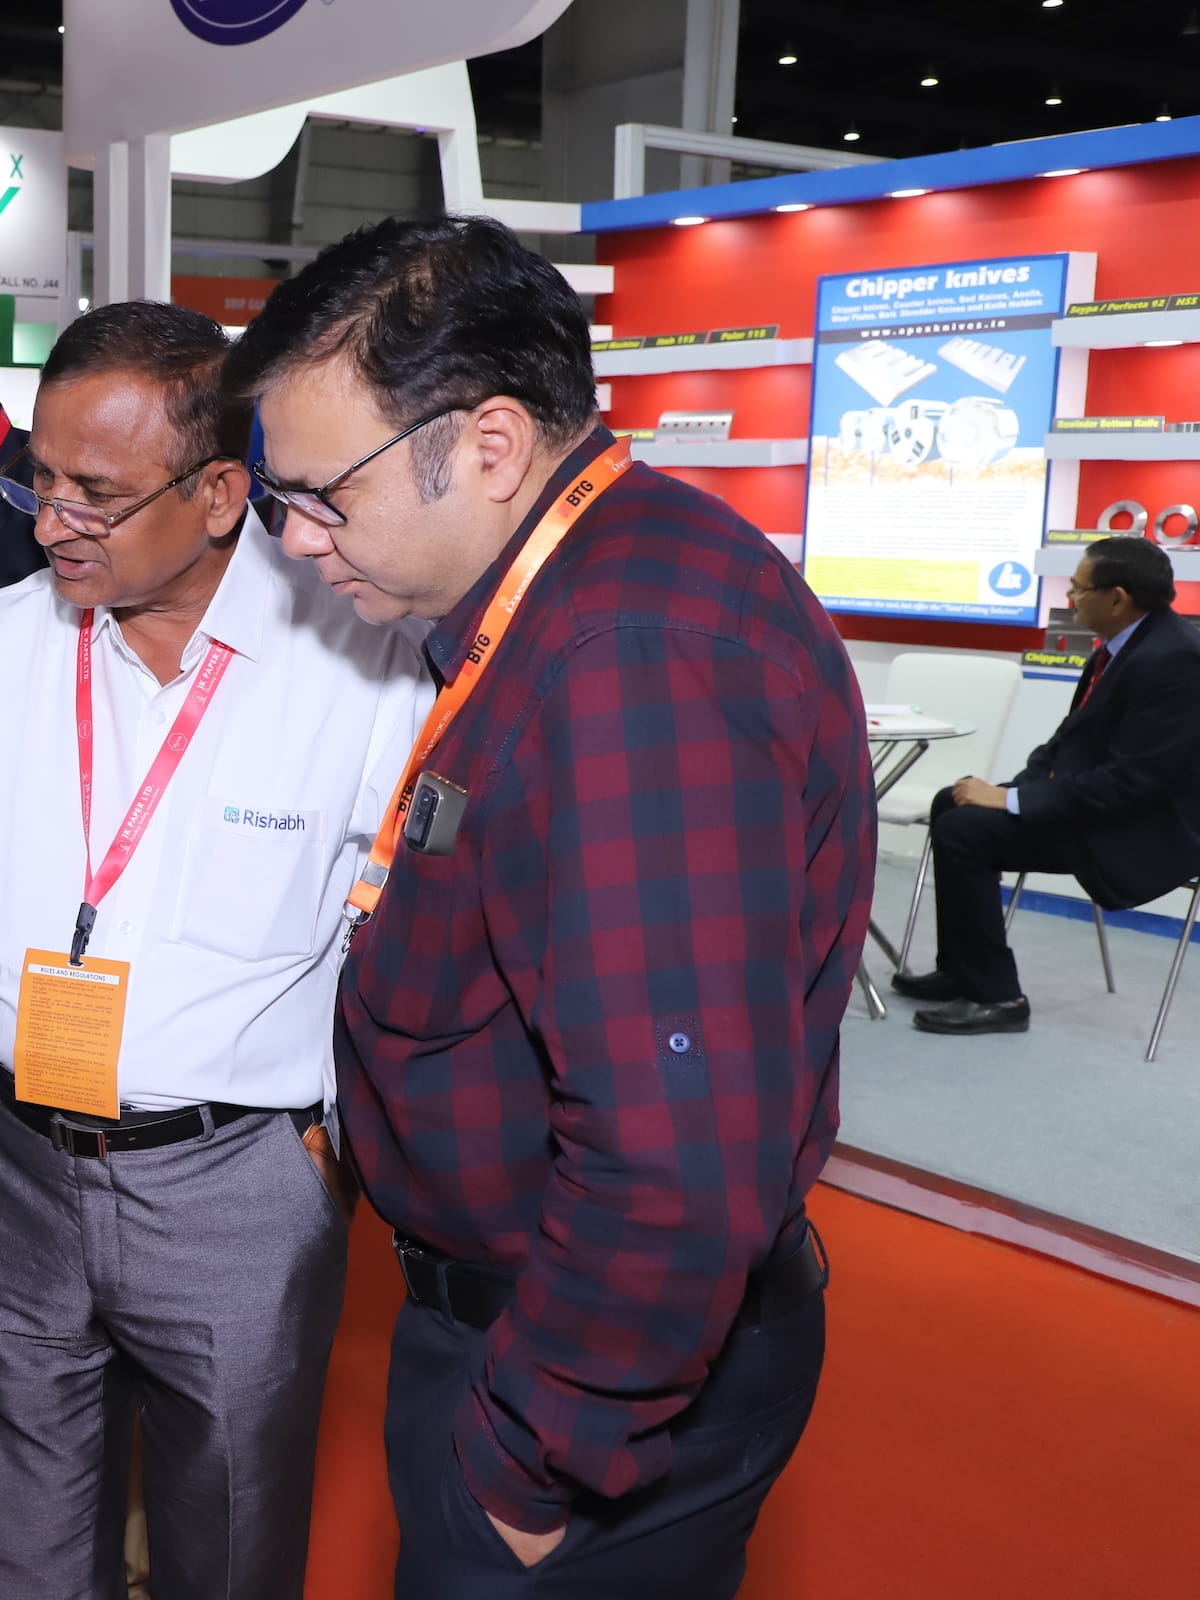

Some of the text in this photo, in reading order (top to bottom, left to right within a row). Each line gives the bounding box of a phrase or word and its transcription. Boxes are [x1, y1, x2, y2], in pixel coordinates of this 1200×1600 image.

[42, 279, 59, 289] J44
[846, 266, 1030, 300] Chipper knives
[1175, 296, 1198, 306] HSS
[861, 319, 1006, 338] www.apexknives.in
[566, 480, 594, 507] BTG
[466, 634, 490, 665] BTG
[202, 654, 219, 679] PAPER
[127, 801, 145, 828] PAPER
[141, 785, 153, 802] LTD
[243, 809, 305, 831] Rishabh
[40, 967, 55, 975] RULES
[69, 970, 106, 982] REGULATIONS
